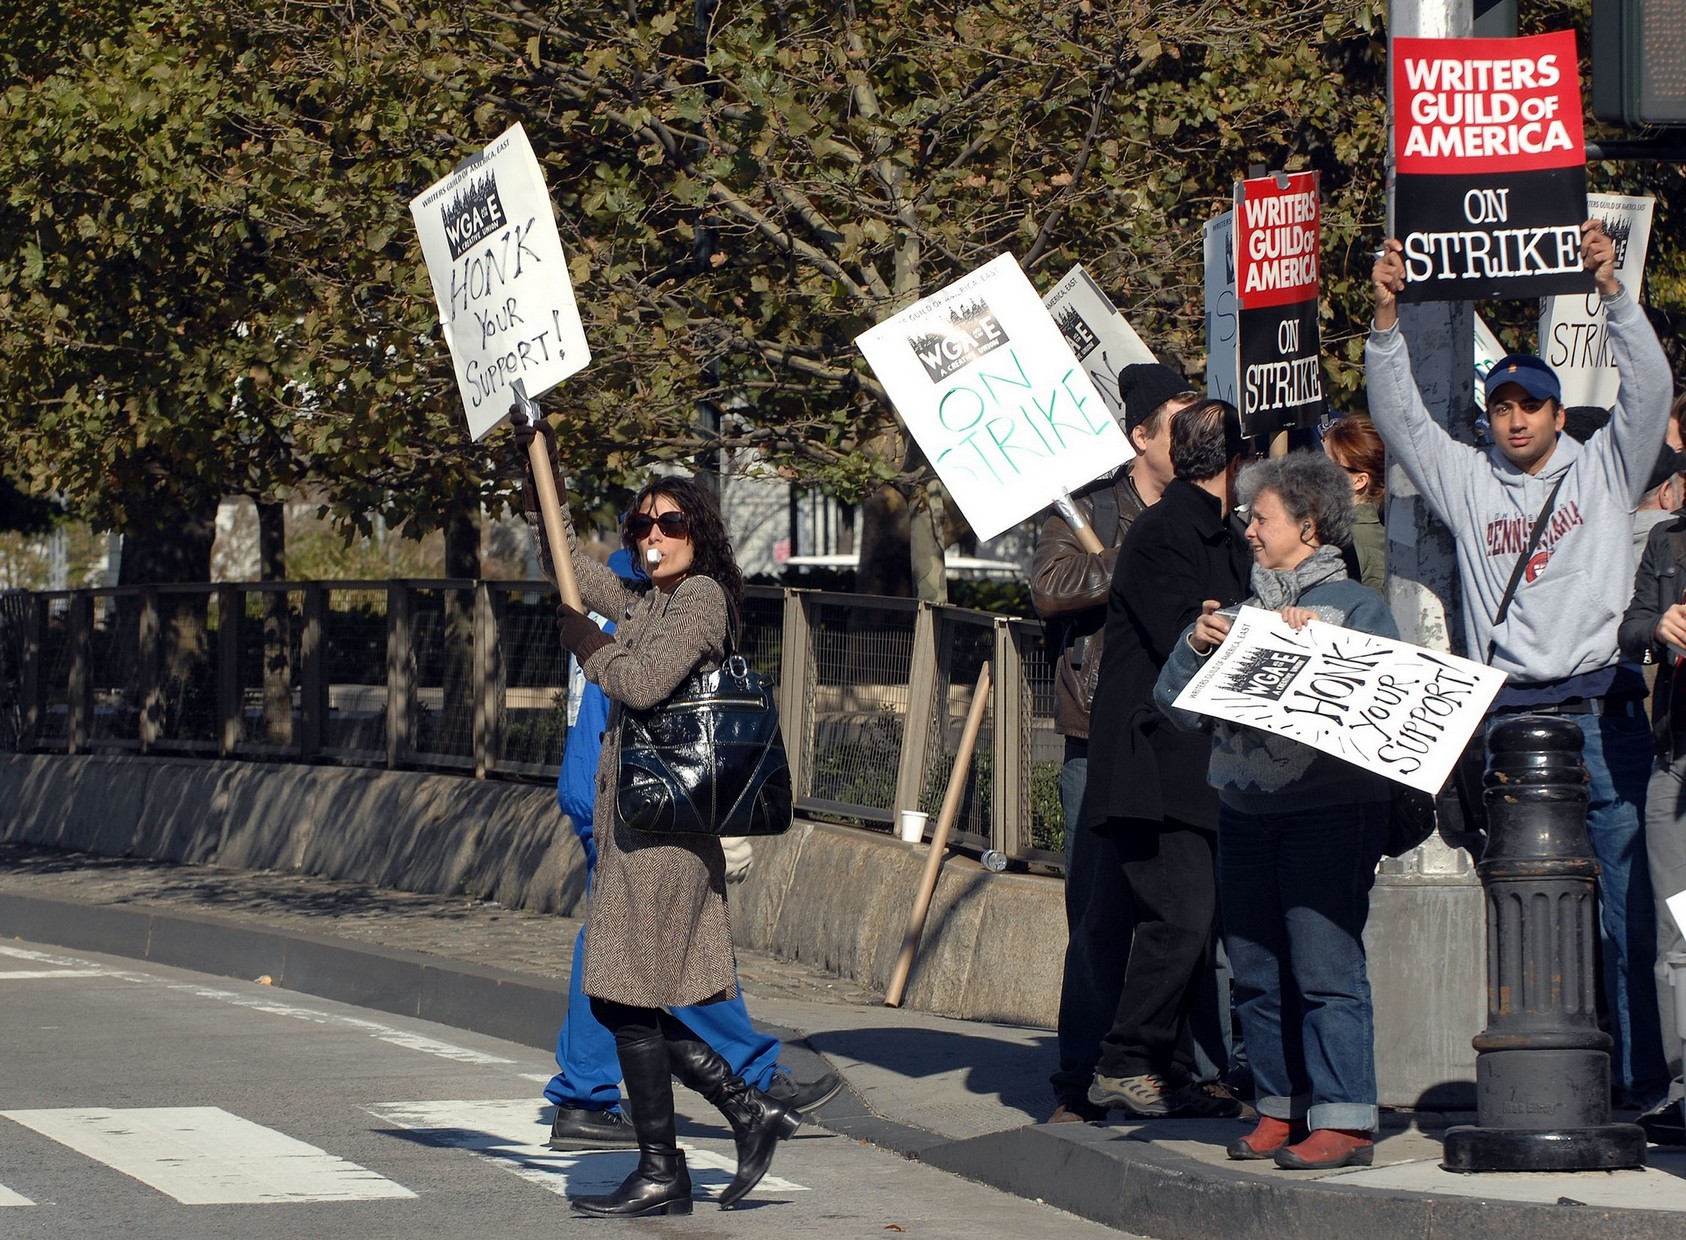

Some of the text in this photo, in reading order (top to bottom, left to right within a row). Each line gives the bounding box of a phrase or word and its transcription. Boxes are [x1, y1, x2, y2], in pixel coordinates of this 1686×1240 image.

[1404, 54, 1560, 92] WRITERS
[1410, 92, 1559, 126] GUILD OF
[1404, 120, 1574, 158] AMERICA
[422, 188, 446, 208] WRITERS
[446, 175, 462, 193] GUILD
[461, 168, 469, 180] OF
[496, 139, 510, 154] EAST
[1244, 191, 1316, 229] WRITERS
[1464, 188, 1508, 225] ON
[1588, 200, 1599, 208] TERS
[457, 220, 500, 255] A CREATIVE UNION
[1249, 226, 1316, 262] GUILD OF
[1404, 224, 1584, 282] STRIKE
[450, 216, 541, 322] HONK
[1065, 278, 1078, 291] EAST
[1244, 254, 1317, 293] AMERICA
[474, 298, 524, 350] YOUR
[908, 304, 932, 321] GUILD
[1586, 293, 1606, 316] O
[1278, 319, 1300, 355] ON
[1551, 322, 1618, 368] STRIK
[940, 368, 947, 378] A
[978, 338, 1000, 354] UNION
[939, 349, 1032, 432] ON
[1245, 354, 1322, 415] STRIKE
[1486, 500, 1584, 557] PENNVANIA
[1190, 678, 1210, 698] WRITERS
[1238, 624, 1251, 640] EAST
[1284, 642, 1394, 726] HONK
[1349, 674, 1420, 742] YOUR
